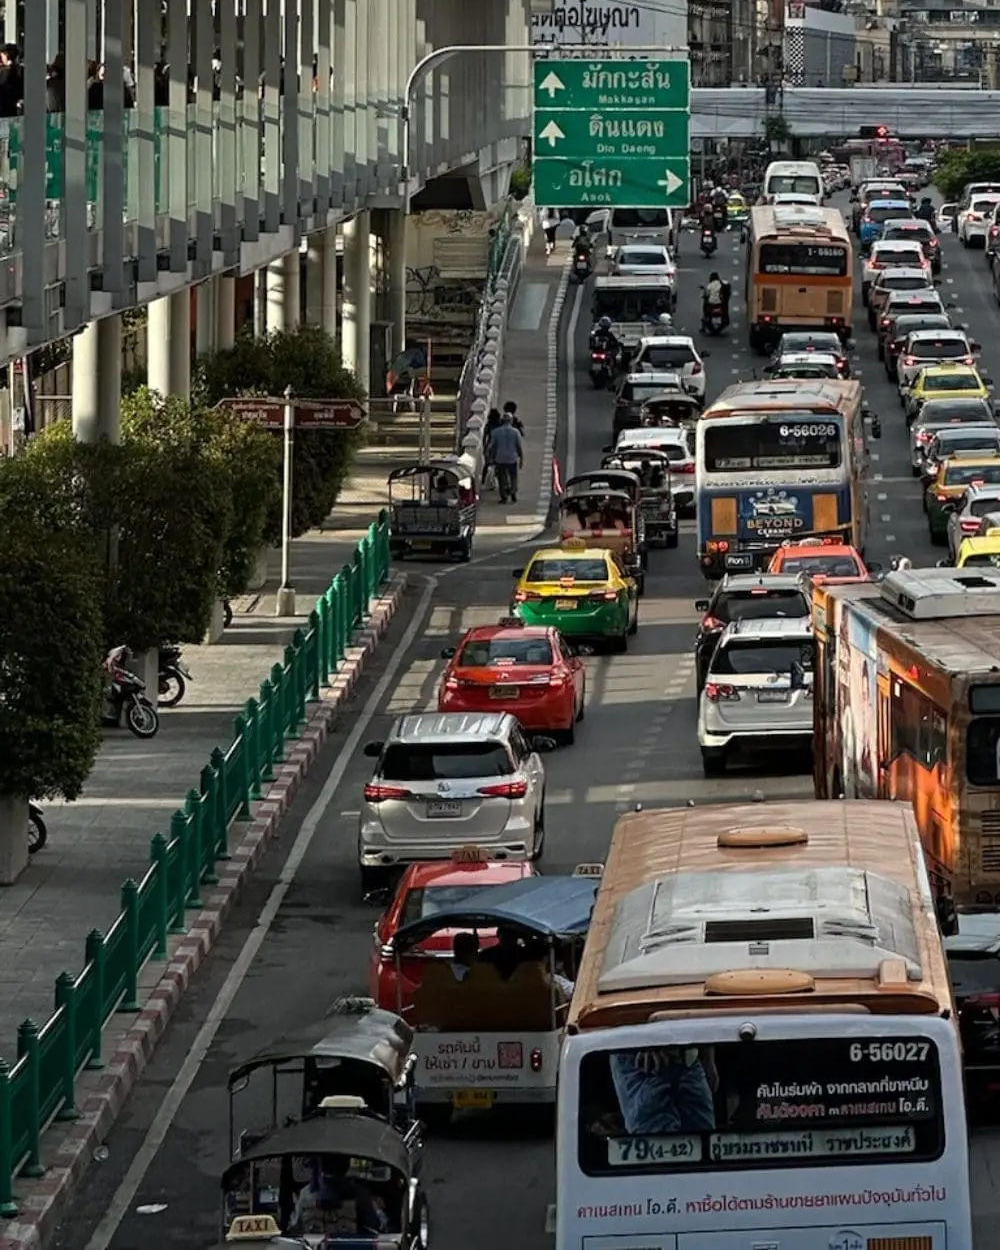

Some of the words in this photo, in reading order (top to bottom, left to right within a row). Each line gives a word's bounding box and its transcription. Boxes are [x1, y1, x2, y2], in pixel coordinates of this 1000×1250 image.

[582, 63, 671, 90] มักกะสัน
[598, 94, 656, 105] Makkasan
[588, 113, 665, 139] ดินแดง
[596, 143, 615, 154] Din
[621, 143, 657, 155] Daeng
[568, 159, 622, 188] อโศก
[580, 192, 612, 202] Asok
[746, 518, 804, 529] BEYOND
[850, 1043, 930, 1061] 6-56027
[577, 1201, 643, 1219] คาเนสเทน
[236, 1219, 271, 1232] TAXI
